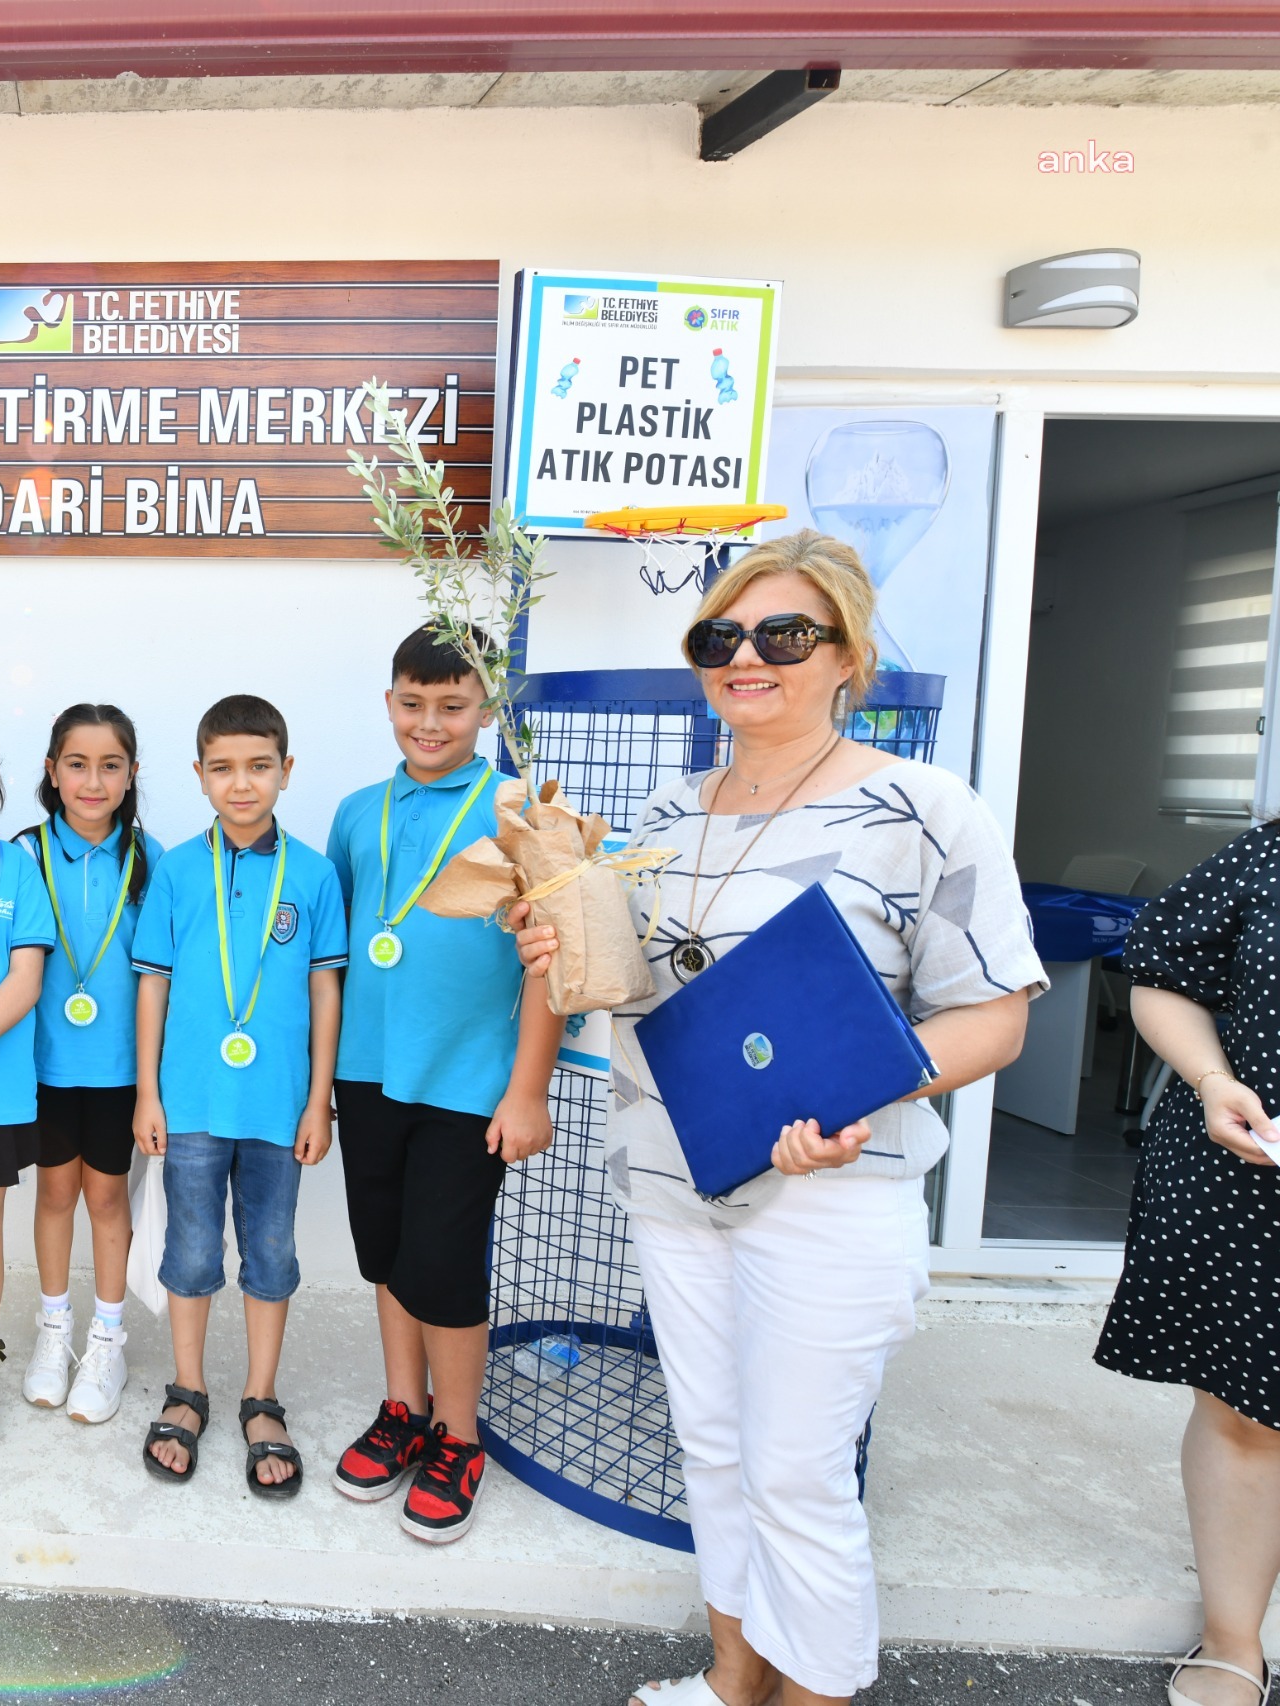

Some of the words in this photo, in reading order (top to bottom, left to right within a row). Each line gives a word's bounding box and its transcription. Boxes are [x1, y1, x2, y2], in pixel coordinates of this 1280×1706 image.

[82, 290, 124, 321] T.C.
[710, 308, 740, 320] SIFIR
[709, 319, 738, 332] ATIK
[618, 355, 680, 390] PET
[198, 373, 461, 446] MERKEZİ
[575, 399, 714, 440] PLASTİK
[536, 448, 614, 483] ATIK
[623, 452, 742, 489] POTASI
[125, 465, 266, 536] BİNA
